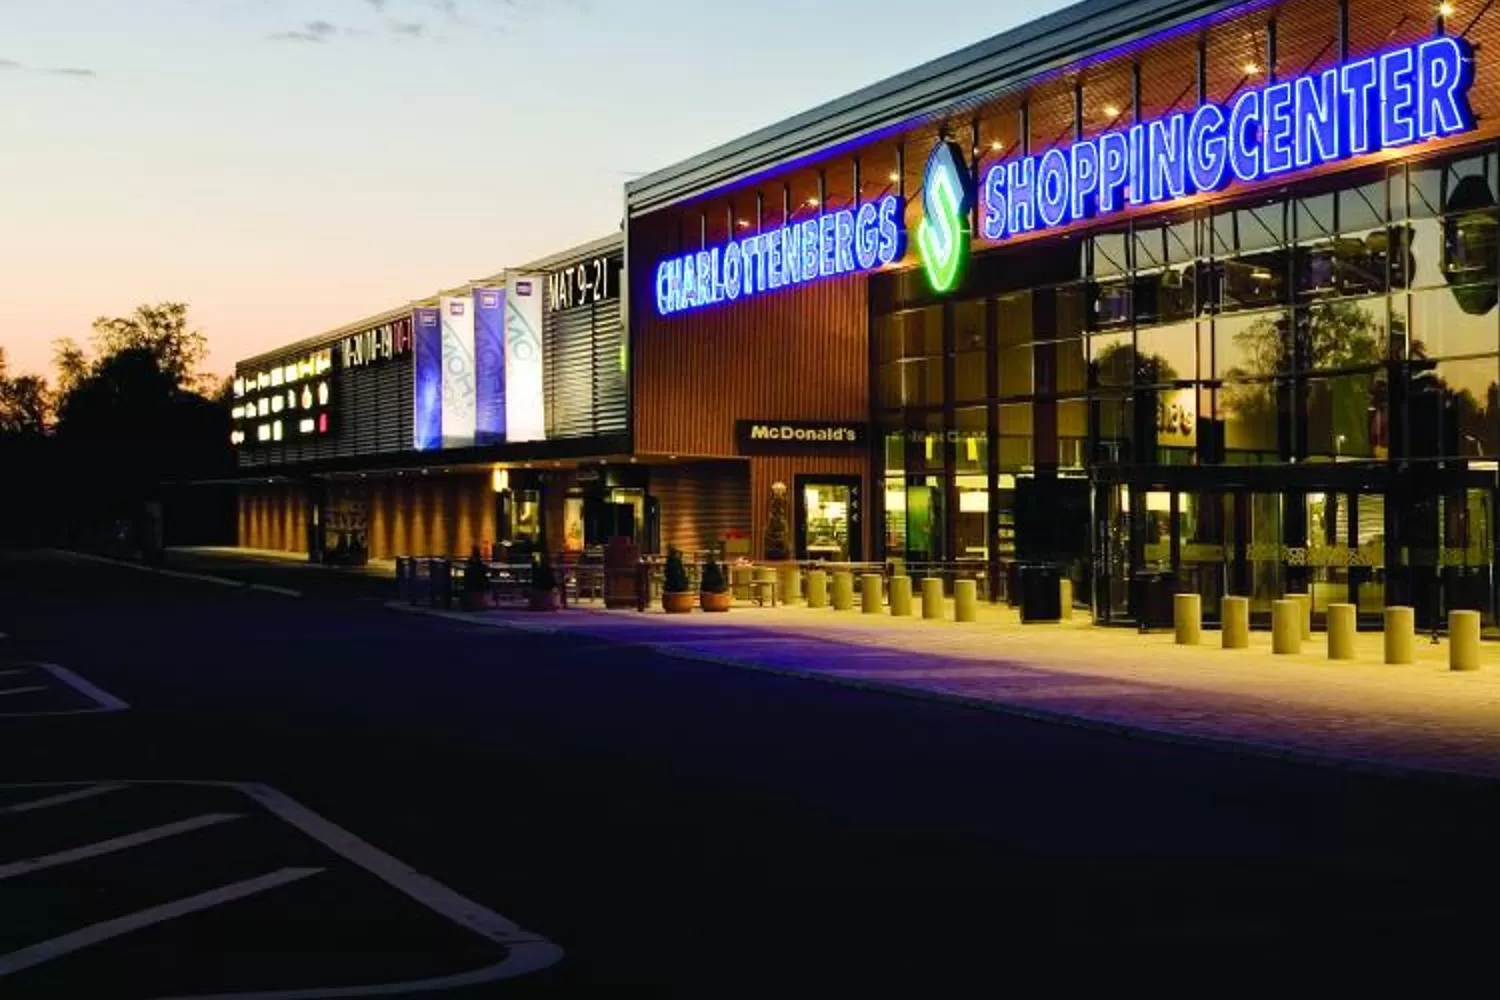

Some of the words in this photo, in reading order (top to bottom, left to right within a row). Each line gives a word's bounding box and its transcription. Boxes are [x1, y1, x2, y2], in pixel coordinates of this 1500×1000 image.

[656, 195, 899, 316] CHARLOTTENBERGS
[984, 37, 1465, 240] SHOPPINGCENTER
[549, 267, 575, 312] MAT
[577, 257, 607, 305] 9-21
[751, 425, 857, 441] McDonald's
